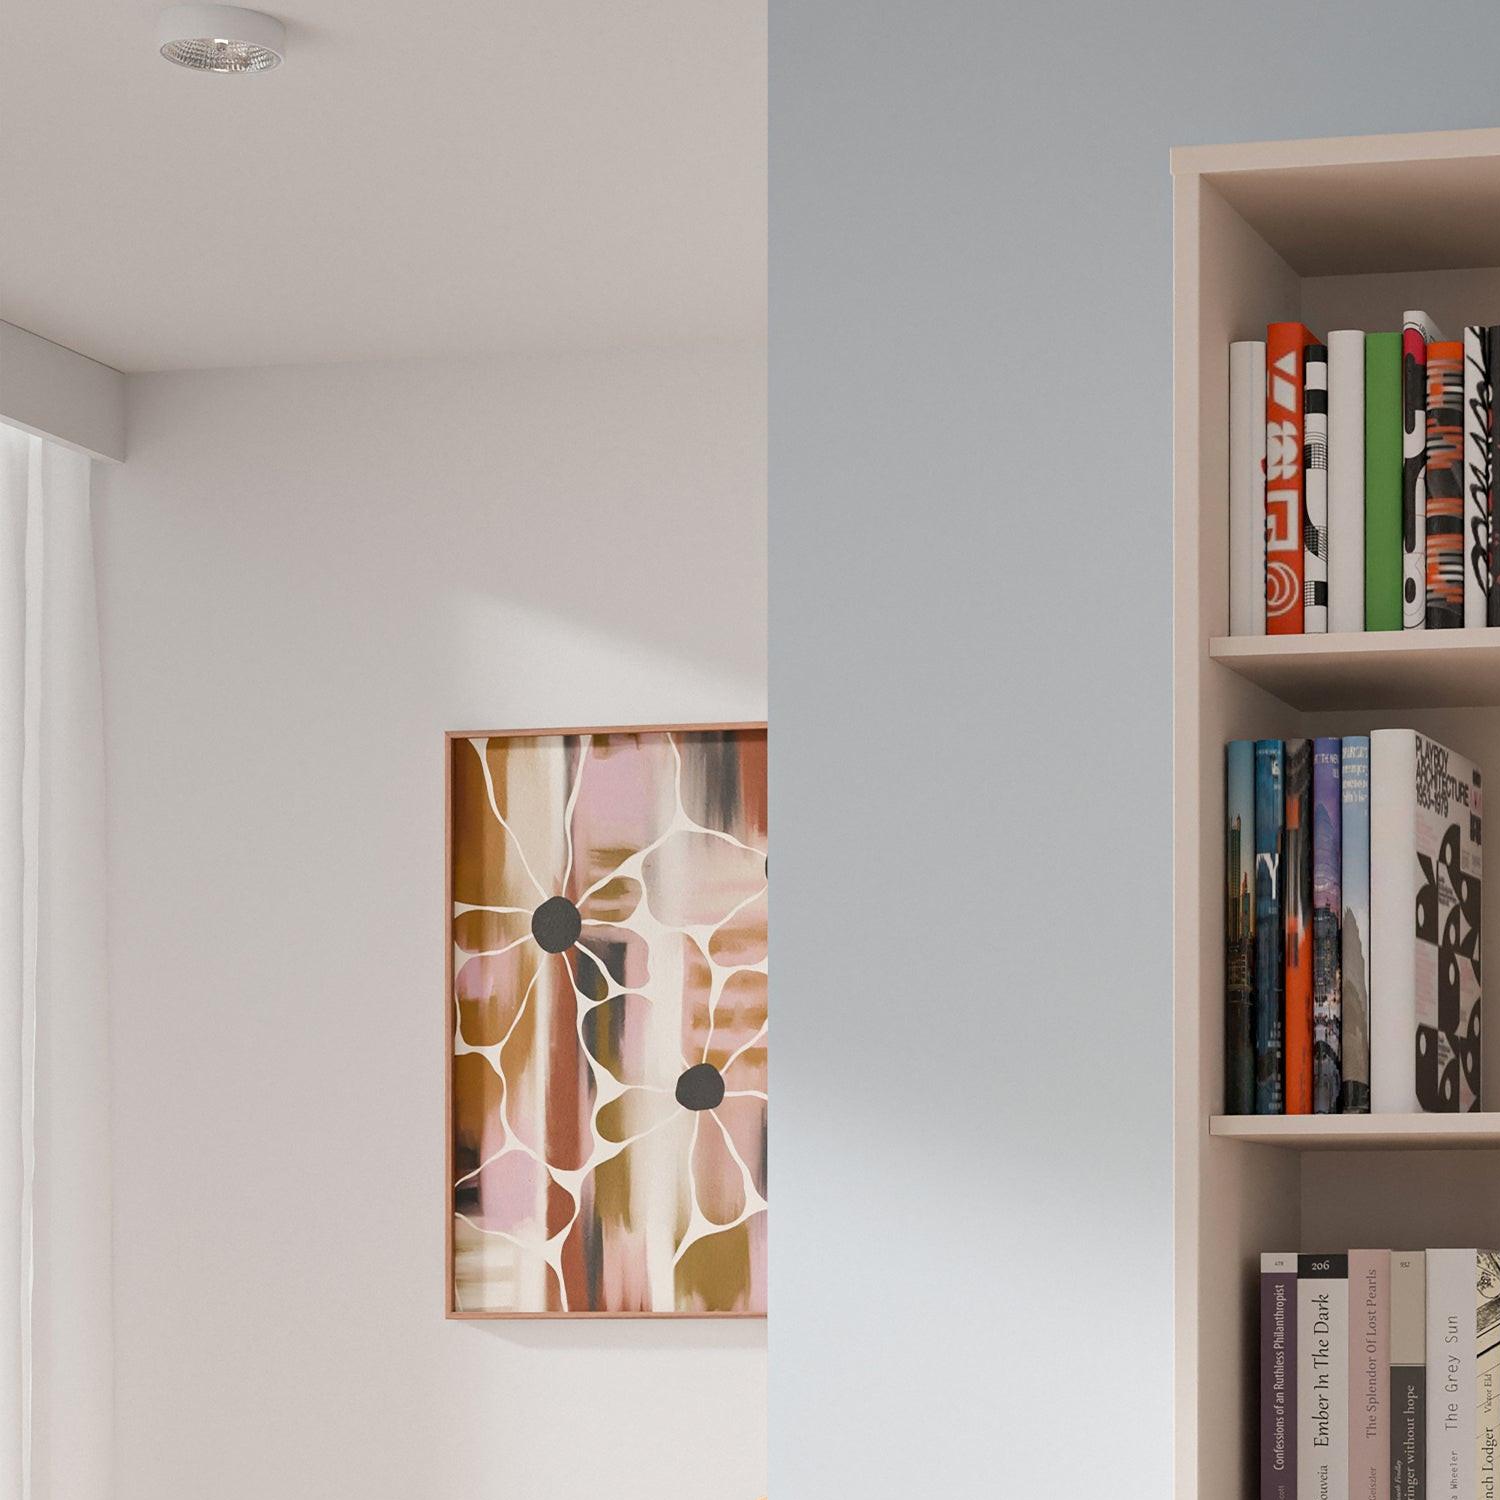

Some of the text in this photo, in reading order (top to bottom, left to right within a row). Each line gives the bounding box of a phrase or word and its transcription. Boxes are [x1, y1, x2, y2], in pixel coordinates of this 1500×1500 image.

[1416, 735, 1448, 777] PLAYBOY
[1416, 758, 1469, 807] ARCHITECTURE
[1312, 1260, 1330, 1270] 206
[1273, 1285, 1286, 1470] Confessions of an Ruthless Philanthropist
[1312, 1294, 1329, 1446] Ember In The Dark
[1445, 1315, 1460, 1430] The Grey Sun
[1403, 1385, 1417, 1414] hope
[1404, 1418, 1415, 1463] without
[1481, 1427, 1497, 1471] Lodger
[1450, 1451, 1458, 1489] Wheeler
